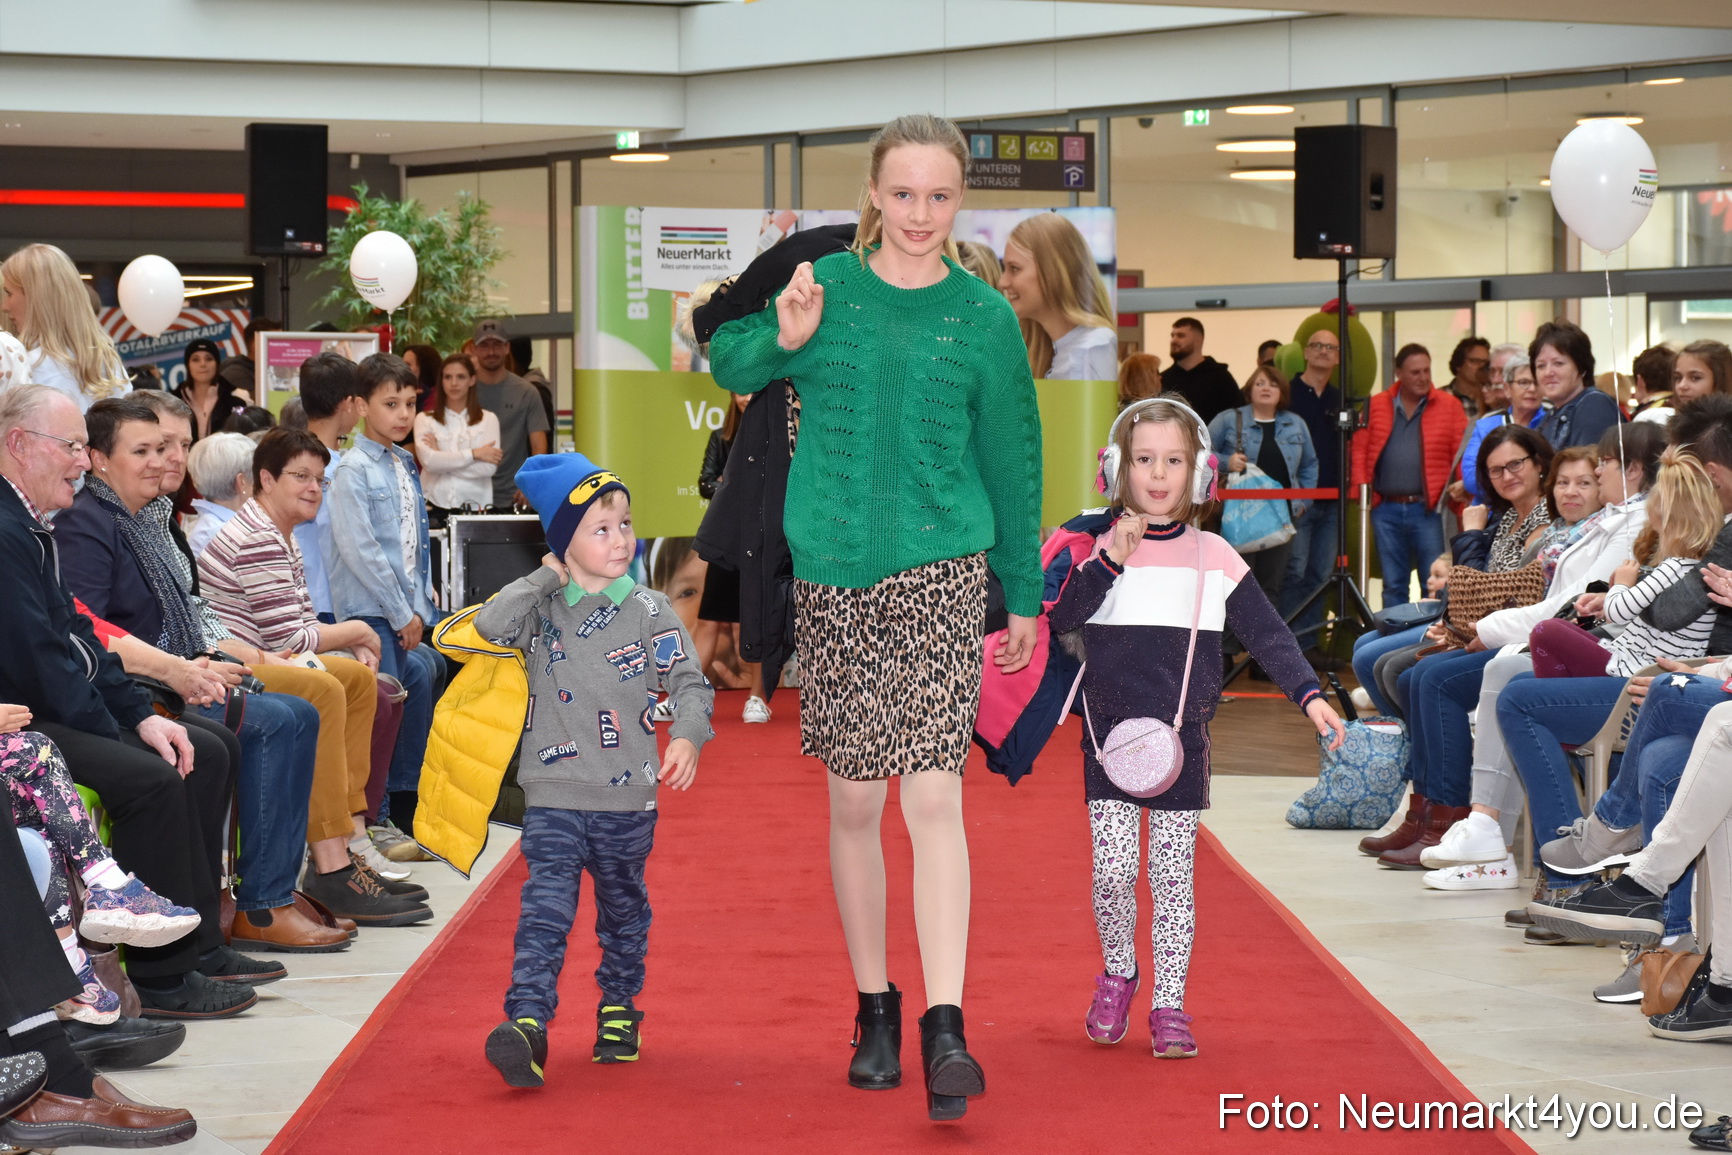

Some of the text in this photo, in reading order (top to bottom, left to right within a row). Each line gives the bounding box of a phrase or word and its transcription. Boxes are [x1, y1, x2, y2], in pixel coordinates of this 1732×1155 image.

[976, 164, 1021, 174] UNTEREN
[1069, 171, 1080, 186] P
[1632, 185, 1656, 200] Neue
[657, 247, 732, 261] NeuerMarkt
[684, 401, 725, 431] Vo
[677, 485, 700, 497] Im St
[588, 609, 602, 621] BLAST
[583, 626, 594, 637] THIS
[595, 614, 605, 624] NOT
[601, 714, 618, 746] 1972
[539, 740, 577, 761] GAME OVER
